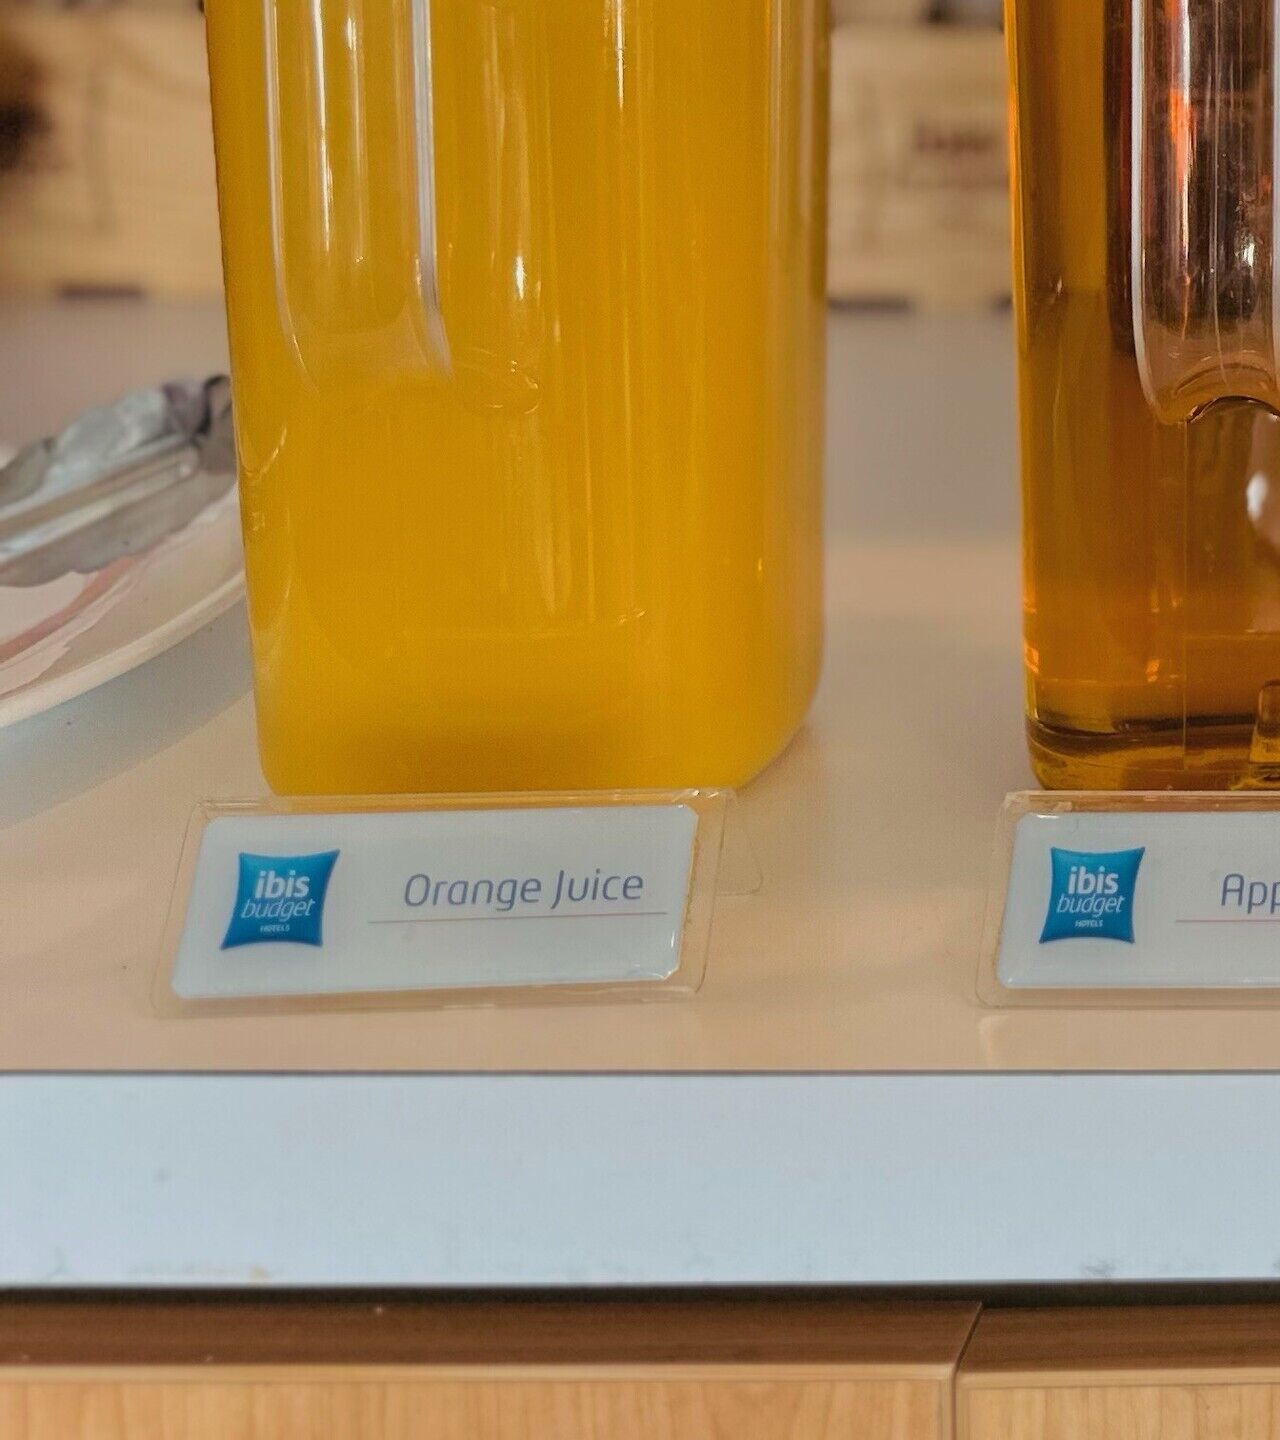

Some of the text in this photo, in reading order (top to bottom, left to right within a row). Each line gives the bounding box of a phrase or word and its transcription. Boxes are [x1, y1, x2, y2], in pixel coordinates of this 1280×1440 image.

[254, 869, 311, 899] ibis
[404, 868, 644, 912] Orange Juice
[1067, 865, 1120, 895] ibis
[240, 898, 316, 923] budget
[1056, 893, 1126, 918] budget
